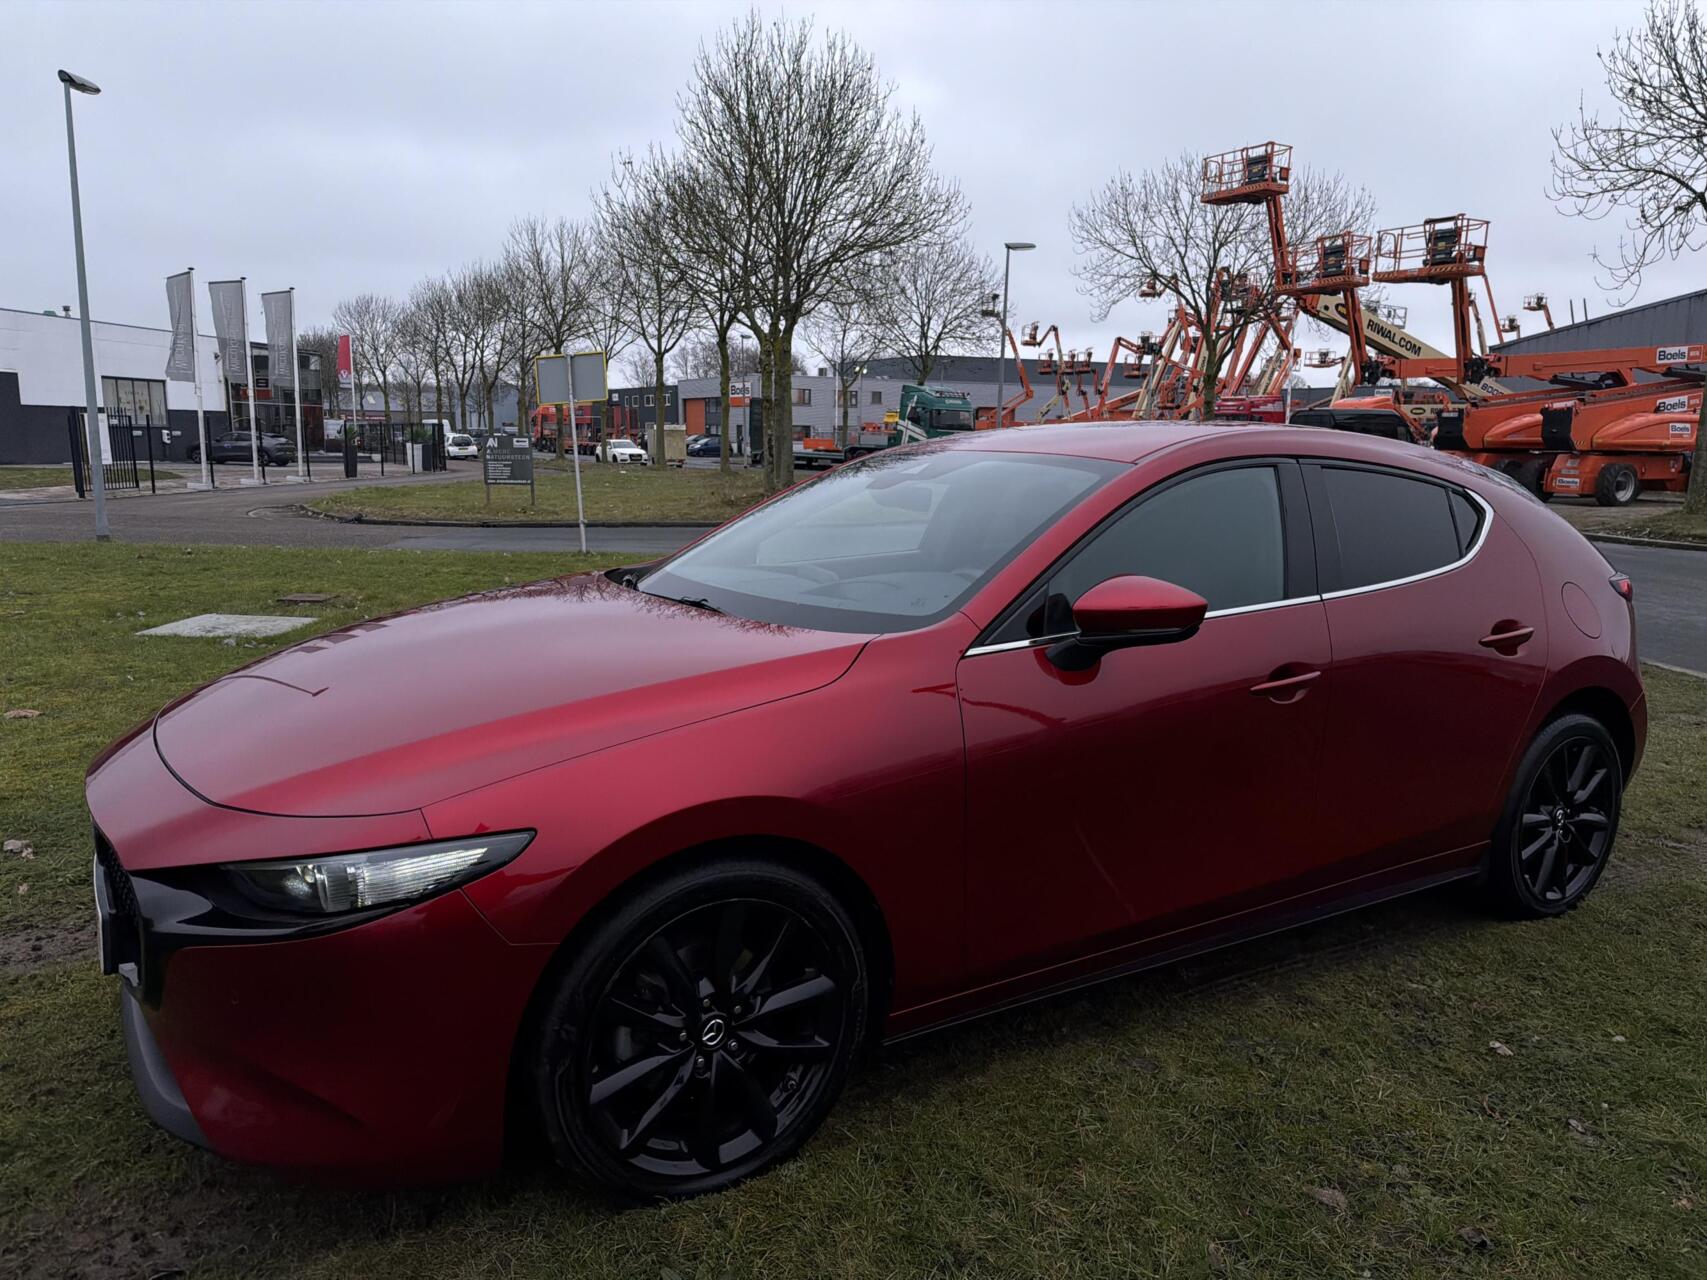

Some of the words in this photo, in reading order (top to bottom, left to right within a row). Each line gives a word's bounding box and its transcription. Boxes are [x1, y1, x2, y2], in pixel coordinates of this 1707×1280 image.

[1366, 319, 1422, 357] RIWAL.COM
[1658, 350, 1686, 361] Boels
[731, 385, 750, 395] Boes
[1657, 400, 1686, 412] Boels
